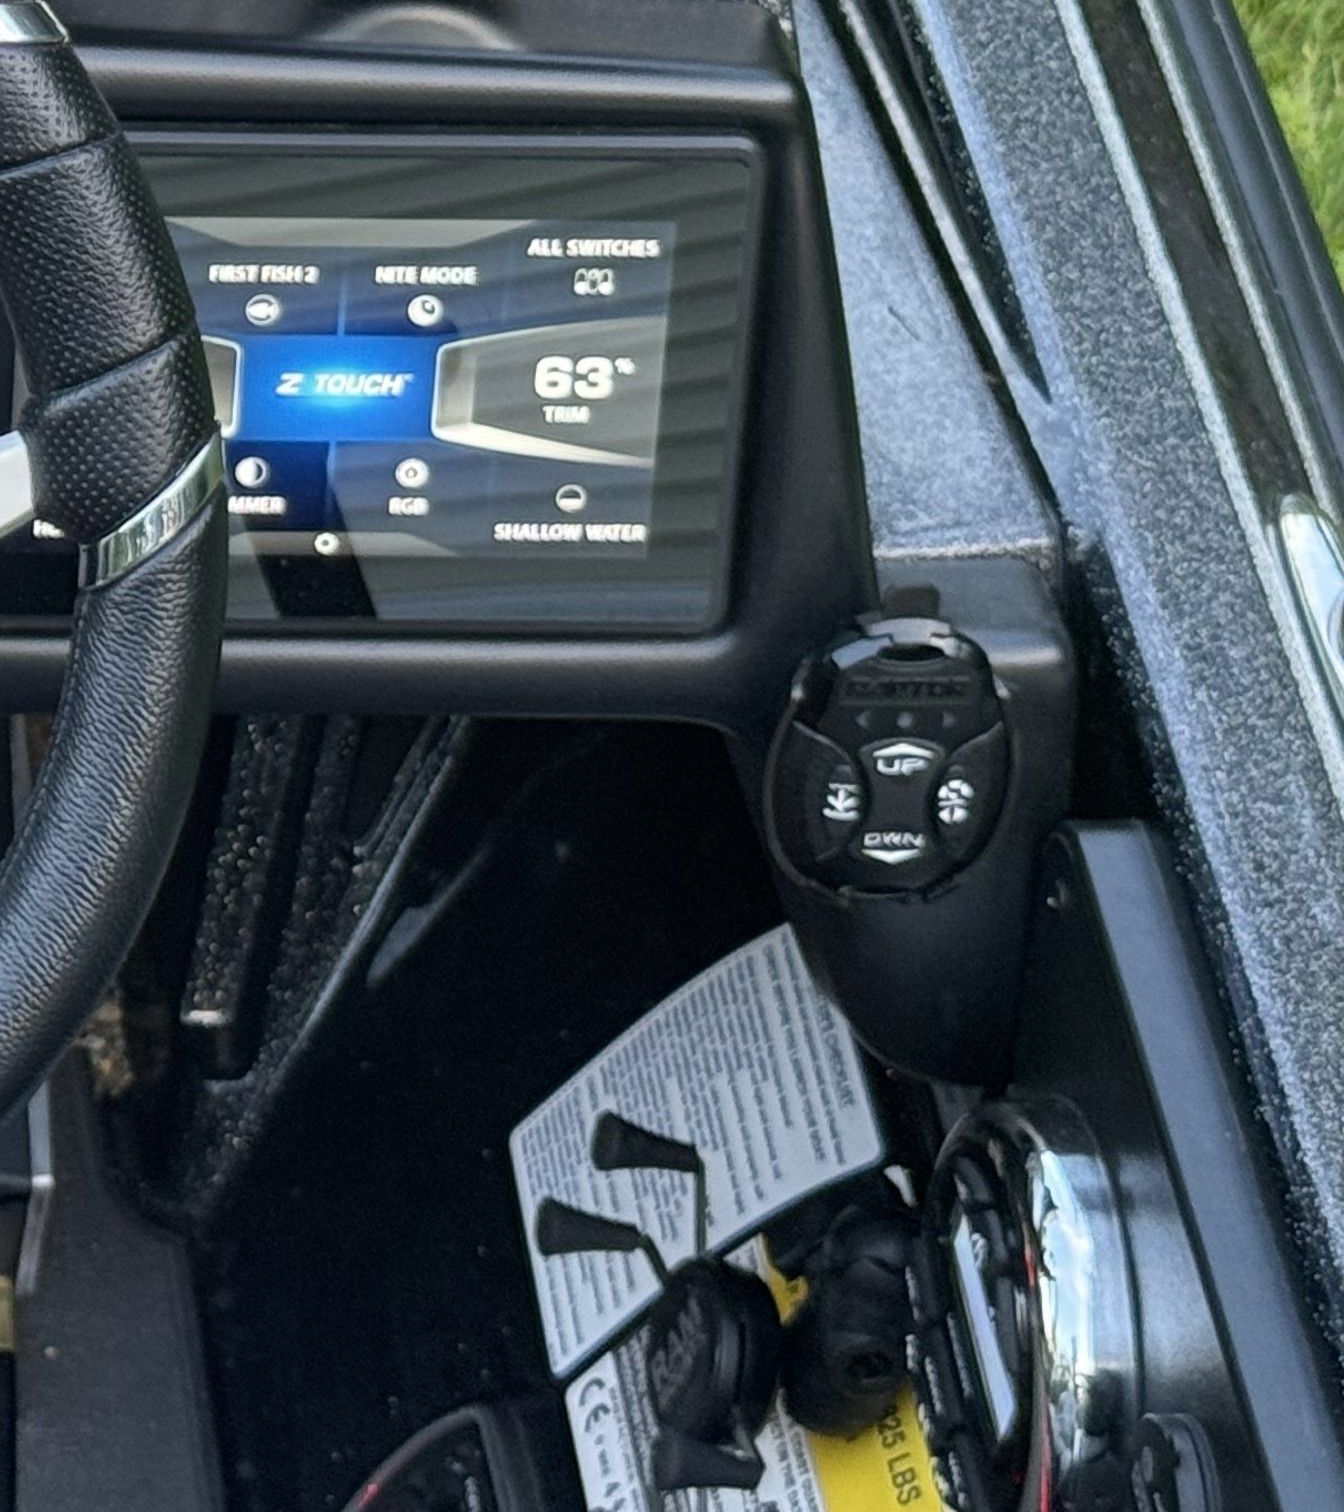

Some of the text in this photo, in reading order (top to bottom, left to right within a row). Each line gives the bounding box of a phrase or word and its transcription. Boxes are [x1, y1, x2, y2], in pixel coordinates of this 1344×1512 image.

[527, 238, 660, 258] ALL SWITCHES
[208, 264, 320, 284] FIRST FISH 2
[375, 266, 478, 285] NITE MODE
[542, 405, 590, 424] TRIM
[227, 495, 287, 516] MMER
[388, 496, 430, 516] RGB
[493, 523, 647, 543] SHALLOW WATER
[876, 757, 929, 776] UP
[887, 1451, 923, 1507] LBS
